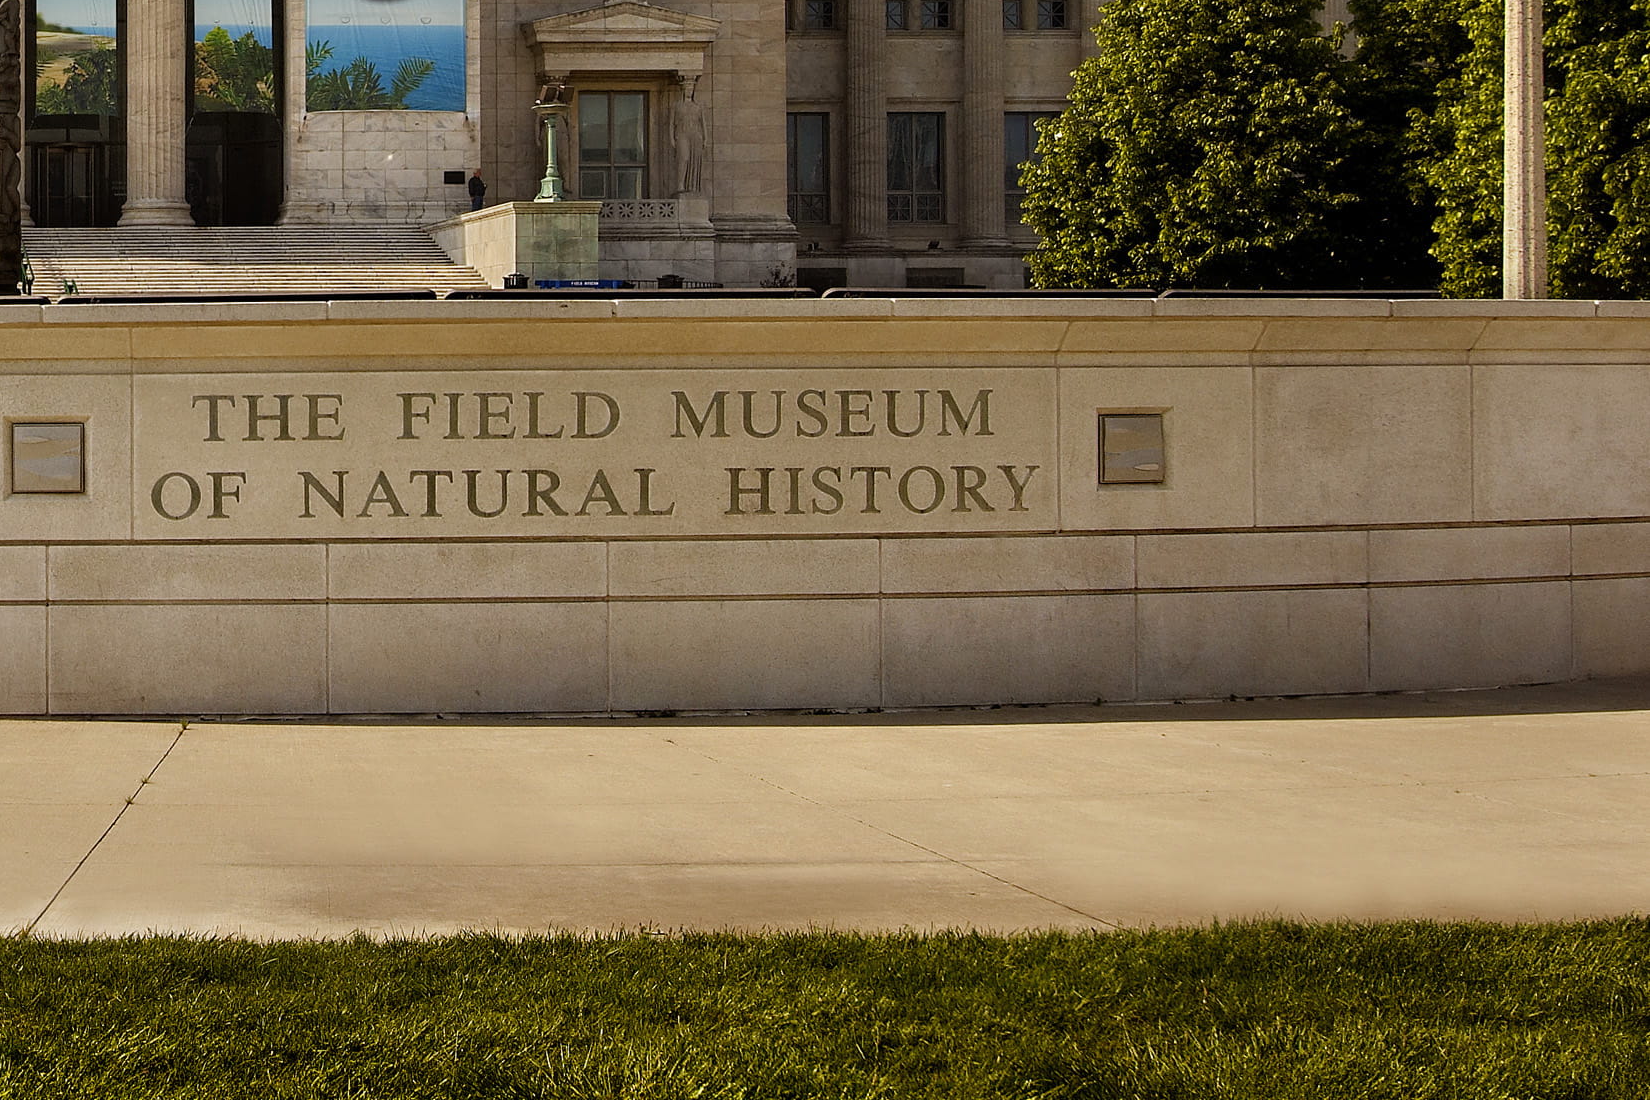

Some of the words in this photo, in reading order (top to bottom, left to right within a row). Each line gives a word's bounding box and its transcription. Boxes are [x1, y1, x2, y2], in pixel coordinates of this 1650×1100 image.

[193, 394, 344, 441] THE
[398, 391, 620, 440] FIELD
[671, 389, 995, 439] MUSEUM
[151, 471, 247, 521] OF
[298, 468, 675, 519] NATURAL
[724, 464, 1041, 516] HISTORY
